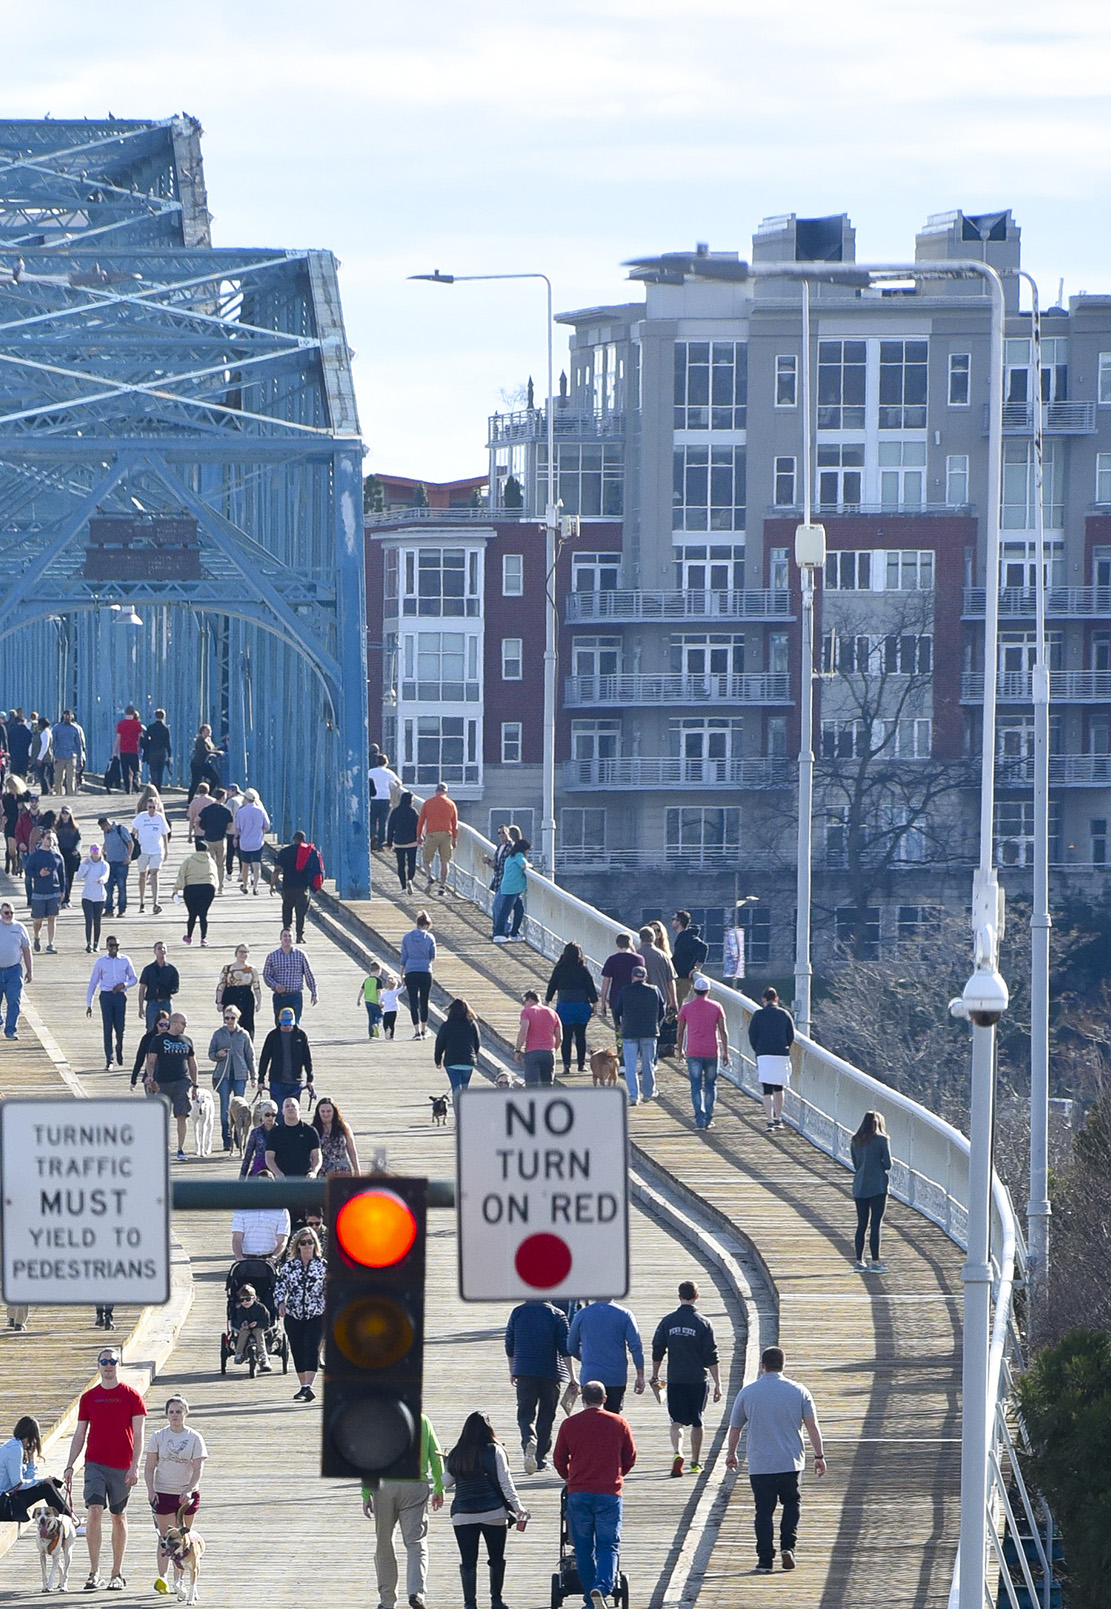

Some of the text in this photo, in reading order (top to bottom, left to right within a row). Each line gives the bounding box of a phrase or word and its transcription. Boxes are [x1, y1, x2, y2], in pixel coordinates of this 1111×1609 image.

[506, 1097, 575, 1138] NO
[34, 1124, 134, 1148] TURNING
[36, 1156, 133, 1178] TRAFFIC
[497, 1149, 590, 1181] TURN
[40, 1189, 127, 1217] MUST
[481, 1193, 618, 1225] ON RED
[29, 1227, 143, 1249] YIELD TO
[13, 1258, 157, 1282] PEDESTRIANS
